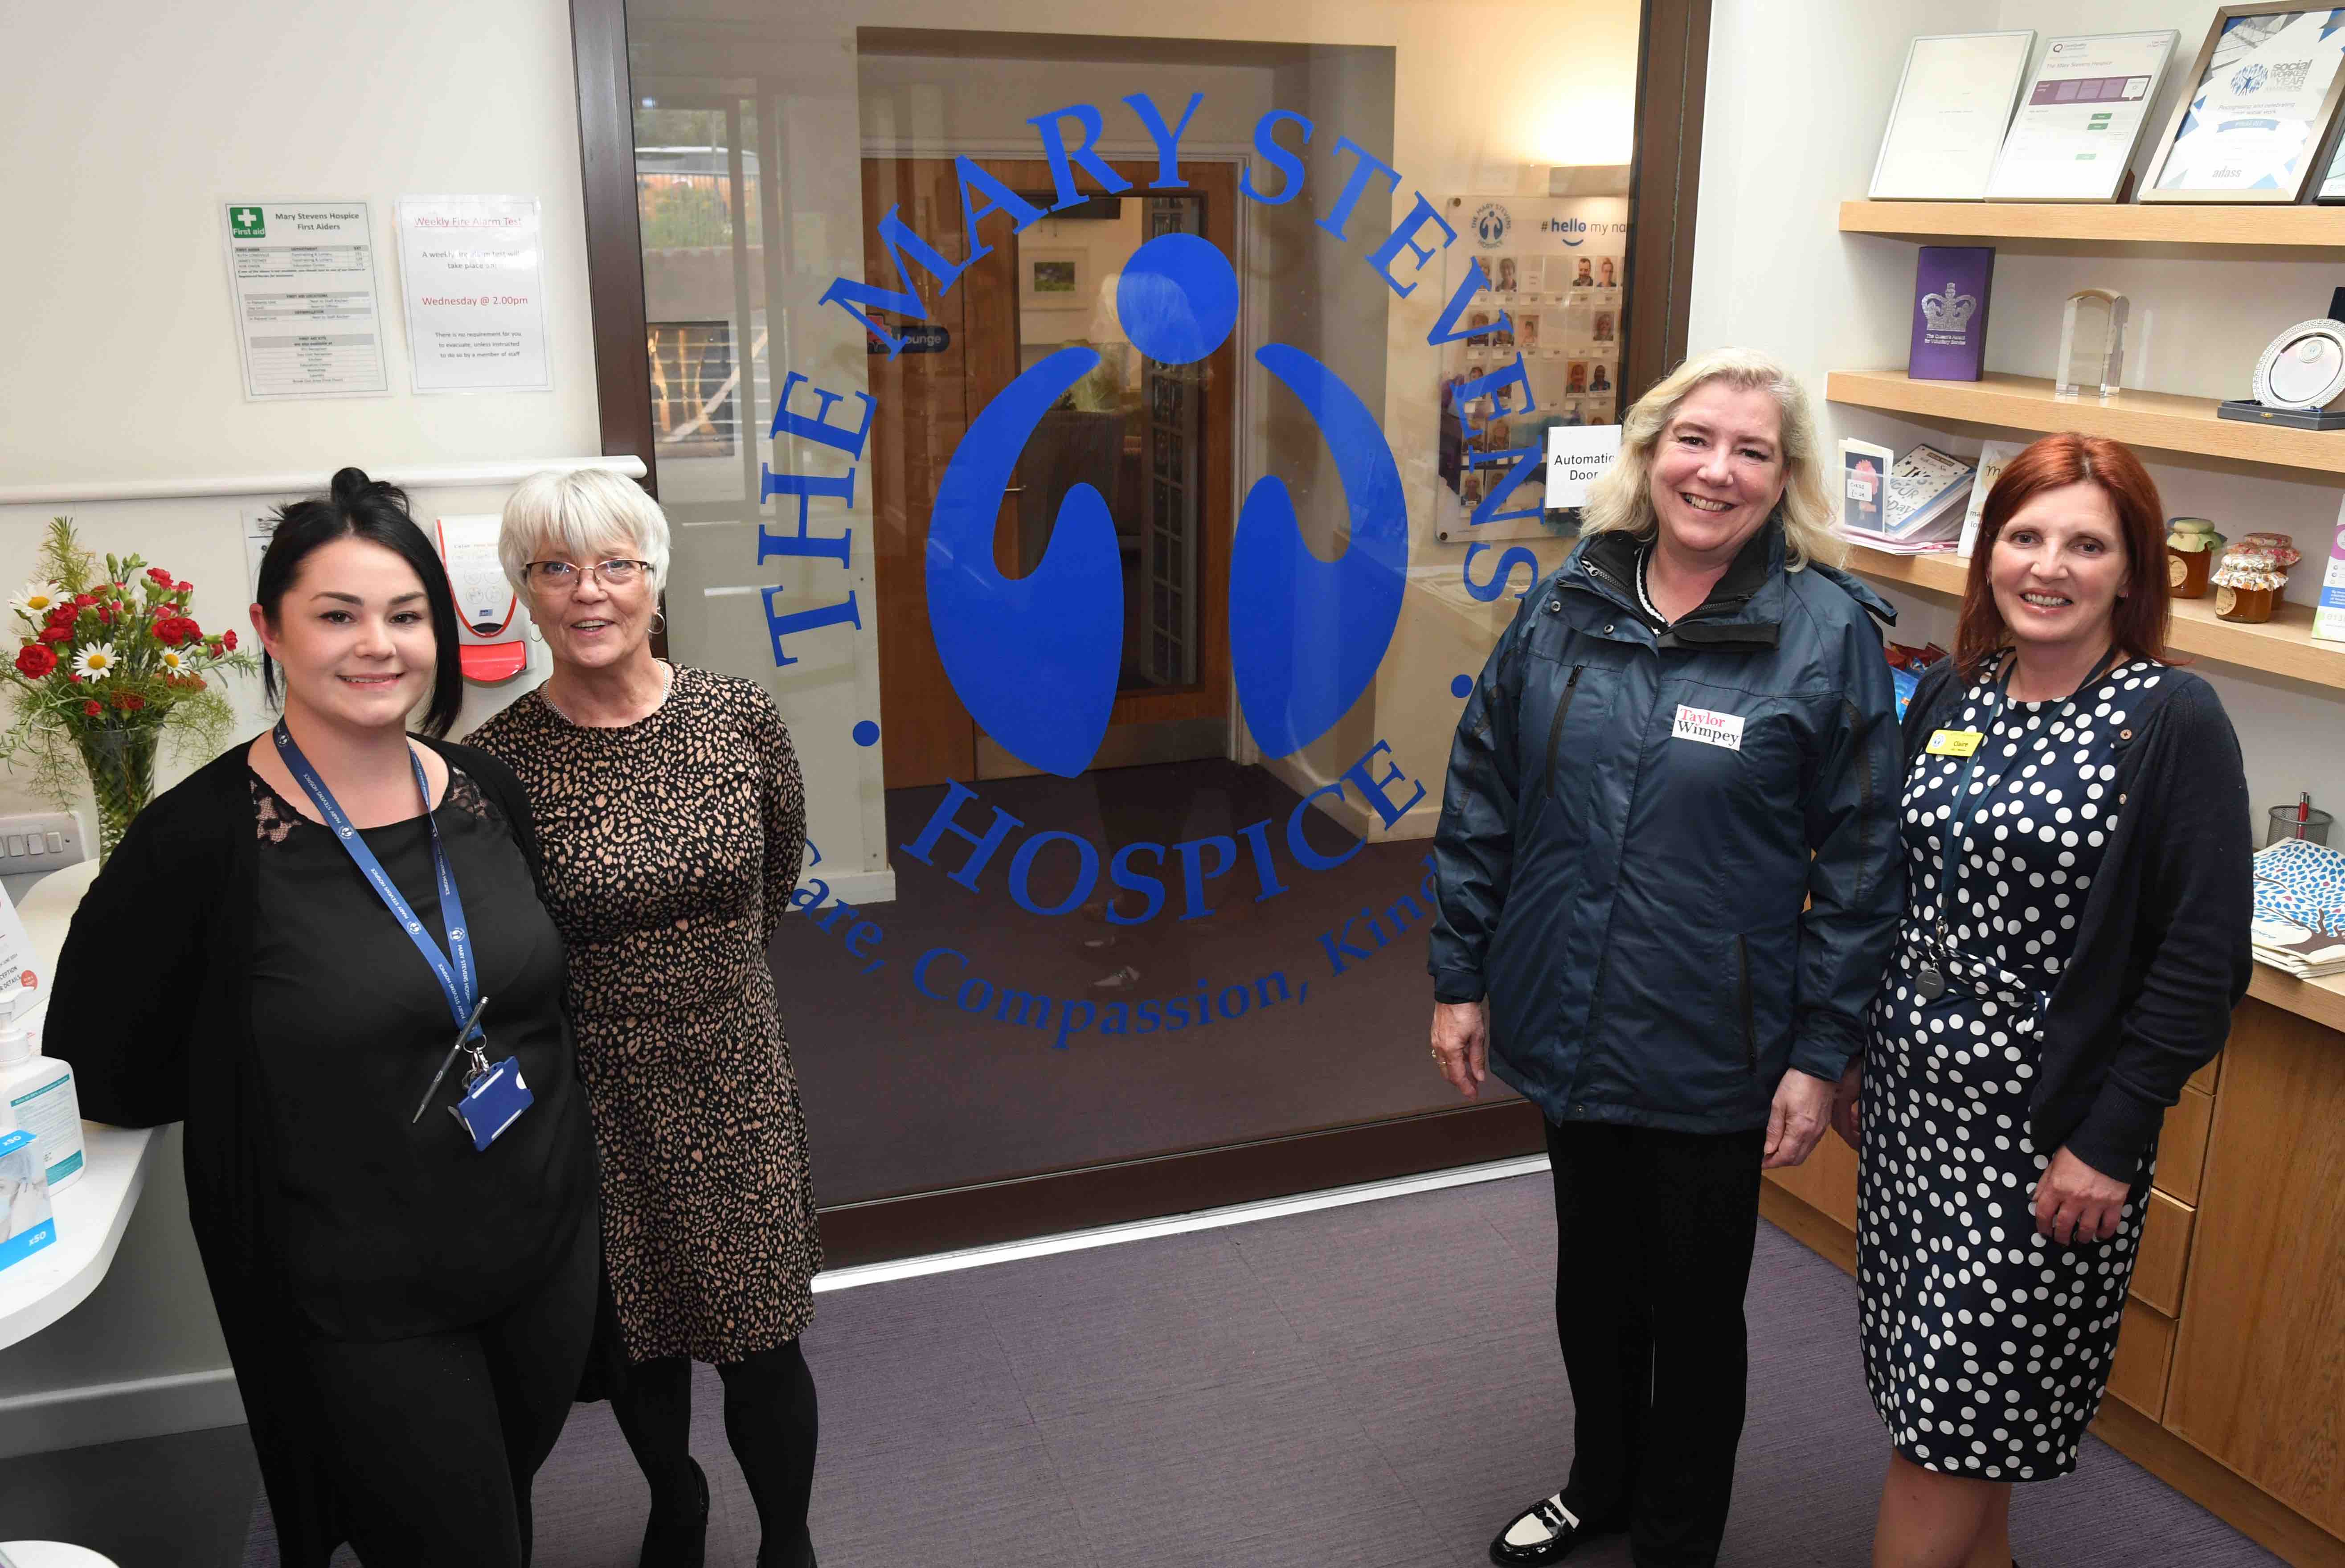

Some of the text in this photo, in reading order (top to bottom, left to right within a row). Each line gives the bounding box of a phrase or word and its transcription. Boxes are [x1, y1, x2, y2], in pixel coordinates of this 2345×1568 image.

[275, 213, 296, 221] Mary
[329, 212, 360, 220] Hospice
[414, 217, 521, 227] Weekly Fire Alarm Test
[252, 227, 265, 235] aid
[1551, 217, 1587, 232] hello
[1591, 223, 1608, 236] my
[464, 262, 483, 270] place
[422, 296, 528, 307] Wednesday @ 2.00pm
[758, 92, 1545, 667] THE MARY STEVENS
[1554, 453, 1615, 465] Automatic
[1570, 470, 1598, 480] Door
[1680, 708, 1726, 727] Taylor
[1677, 720, 1740, 746] Wimpey
[900, 740, 1426, 926] HOSPICE
[912, 947, 1309, 1049] Compassion,
[3, 1135, 22, 1146] x50
[29, 1231, 46, 1247] x50
